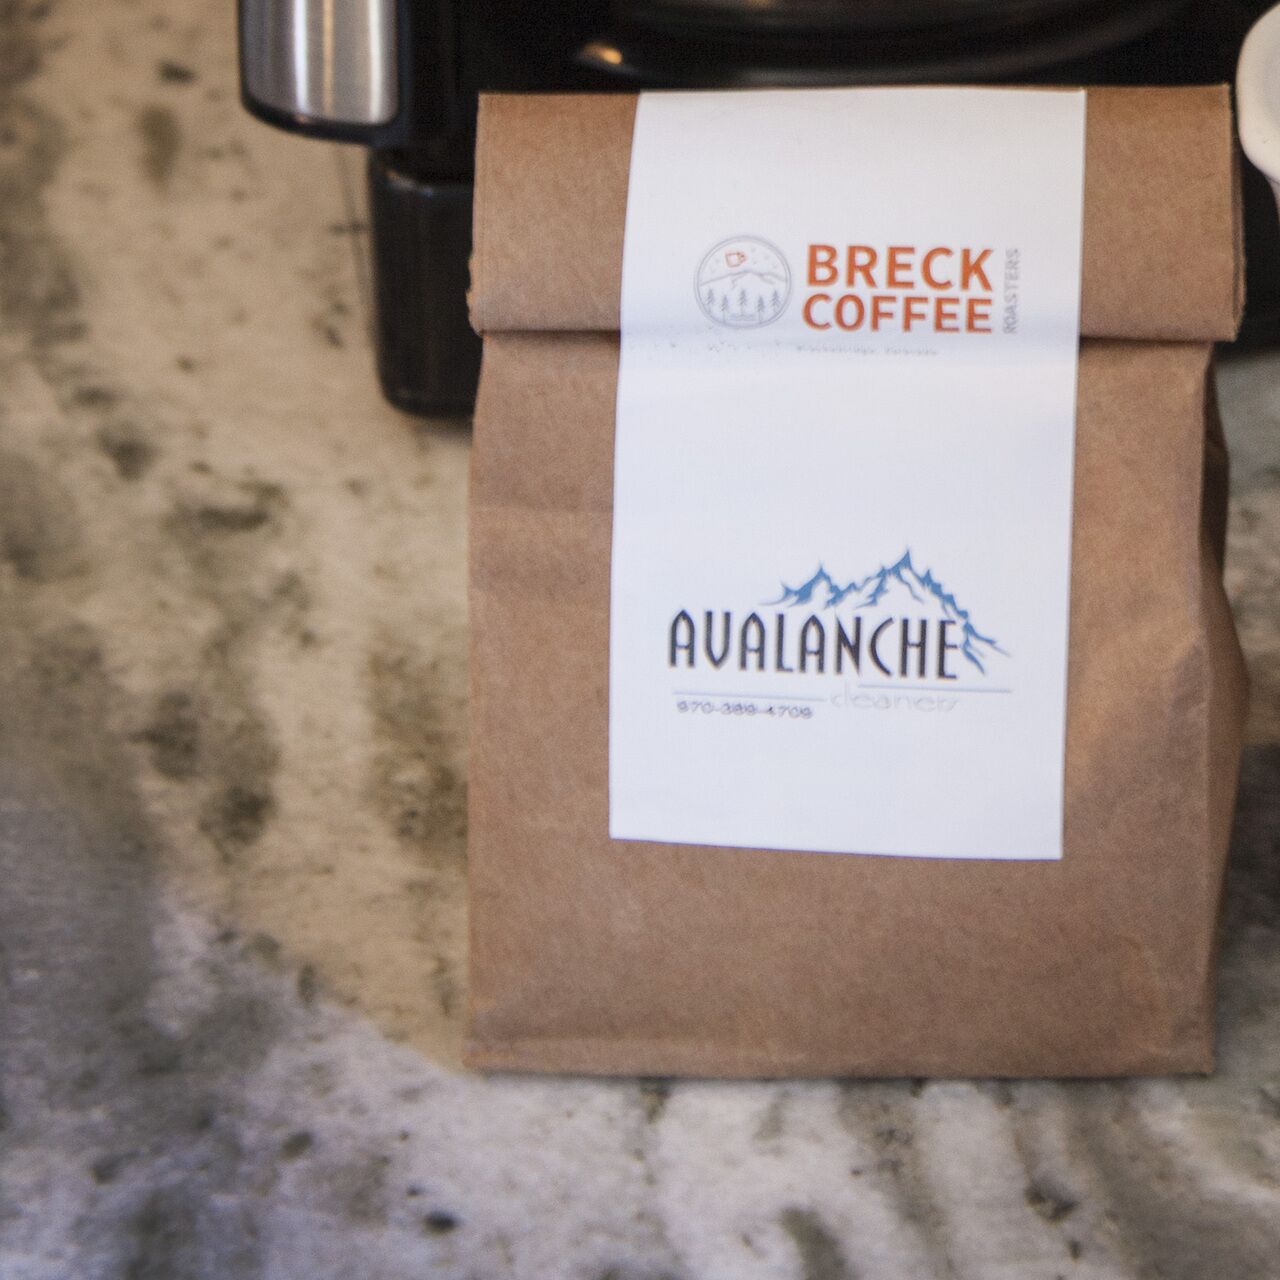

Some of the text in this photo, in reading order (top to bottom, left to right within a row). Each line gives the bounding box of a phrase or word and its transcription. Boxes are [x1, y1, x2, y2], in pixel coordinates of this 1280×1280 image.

[806, 243, 993, 292] BRECK
[802, 292, 993, 334] COFFEE
[668, 608, 958, 680] AVALANCHE
